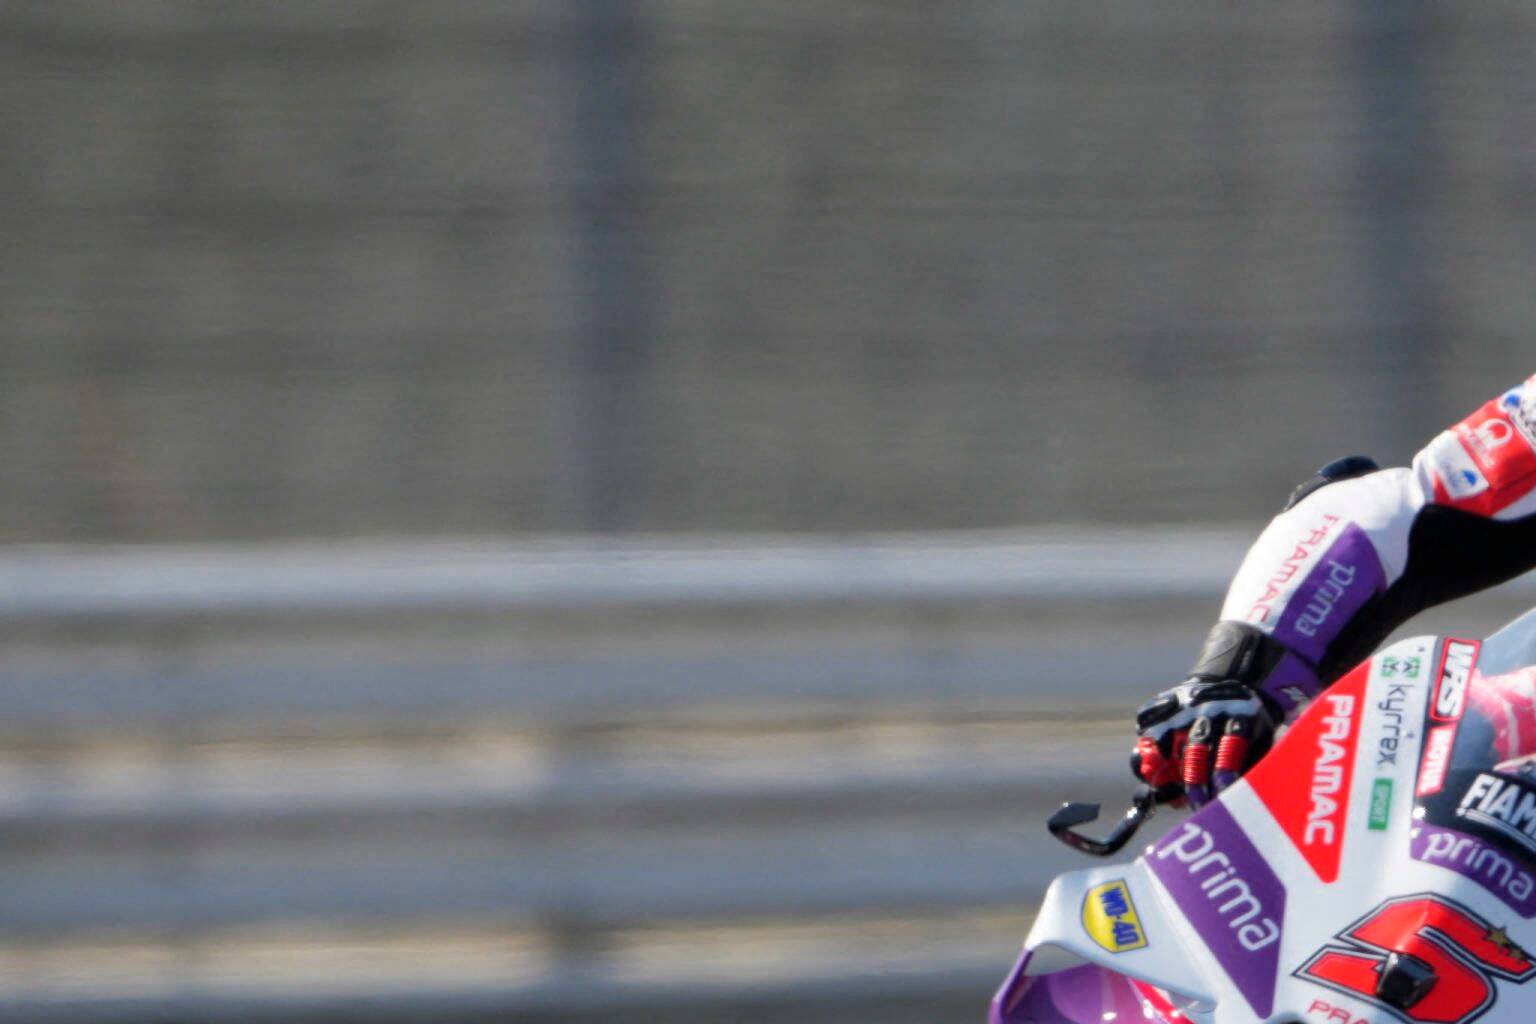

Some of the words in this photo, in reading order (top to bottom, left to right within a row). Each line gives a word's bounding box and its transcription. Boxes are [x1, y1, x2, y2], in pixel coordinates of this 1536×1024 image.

[1436, 641, 1475, 718] WRS
[1303, 694, 1355, 846] PRAMAC
[1157, 822, 1279, 951] prima
[1427, 831, 1534, 901] prima
[1100, 887, 1139, 947] WD-40
